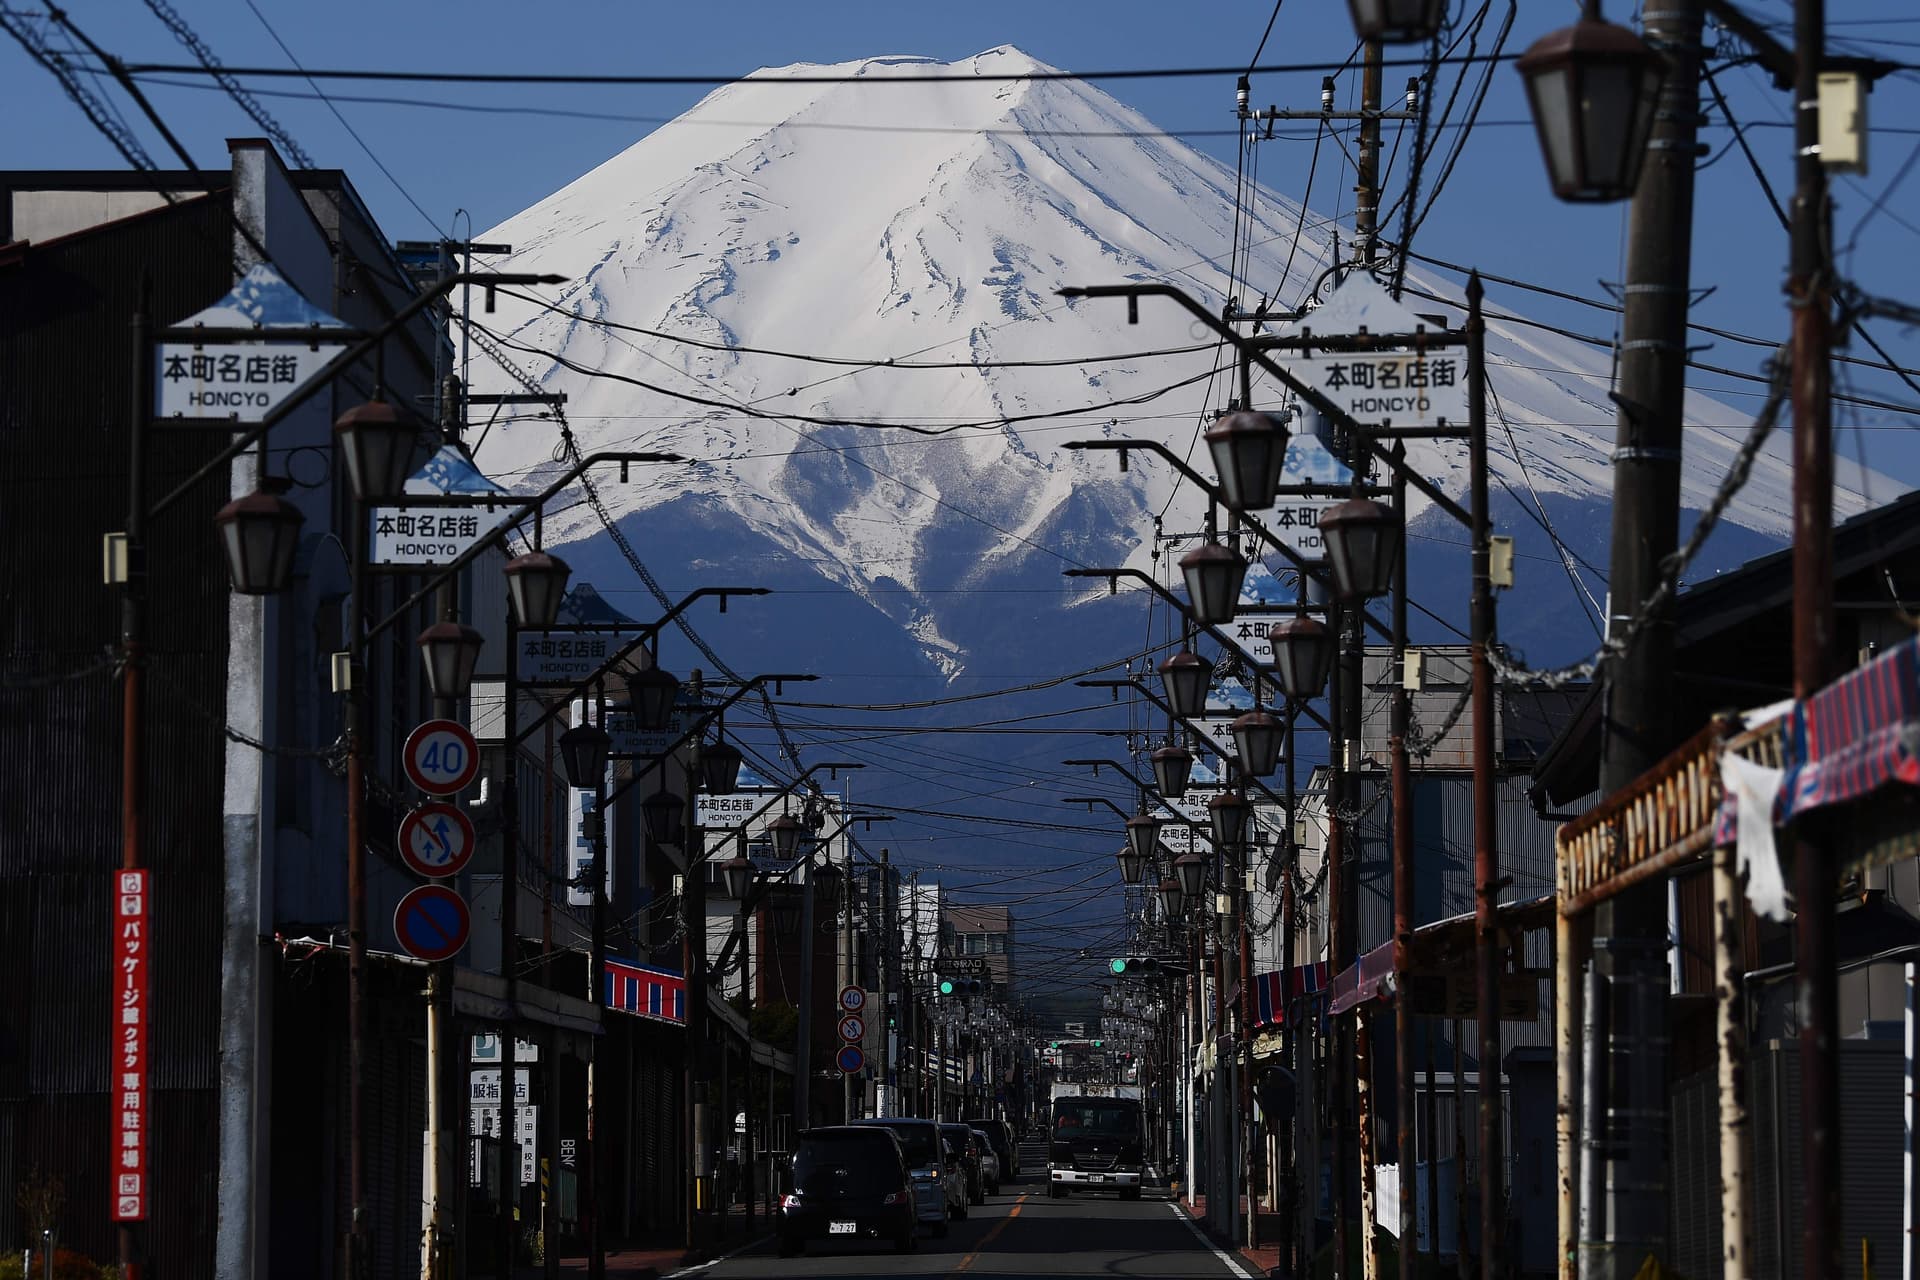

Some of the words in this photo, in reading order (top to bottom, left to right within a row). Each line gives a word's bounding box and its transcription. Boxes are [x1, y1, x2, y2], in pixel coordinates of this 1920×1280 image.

[164, 354, 297, 384] 本町名店街
[1325, 359, 1456, 391] 本町名店街
[376, 514, 478, 538] 本町名店街
[1277, 506, 1329, 530] 本町
[1237, 621, 1281, 641] 本町
[524, 639, 606, 658] 本町名店街
[1254, 645, 1274, 656] HO
[421, 740, 463, 774] 40
[698, 799, 754, 812] 本町名店街
[845, 992, 861, 1006] 40
[470, 1083, 526, 1099] 服指店
